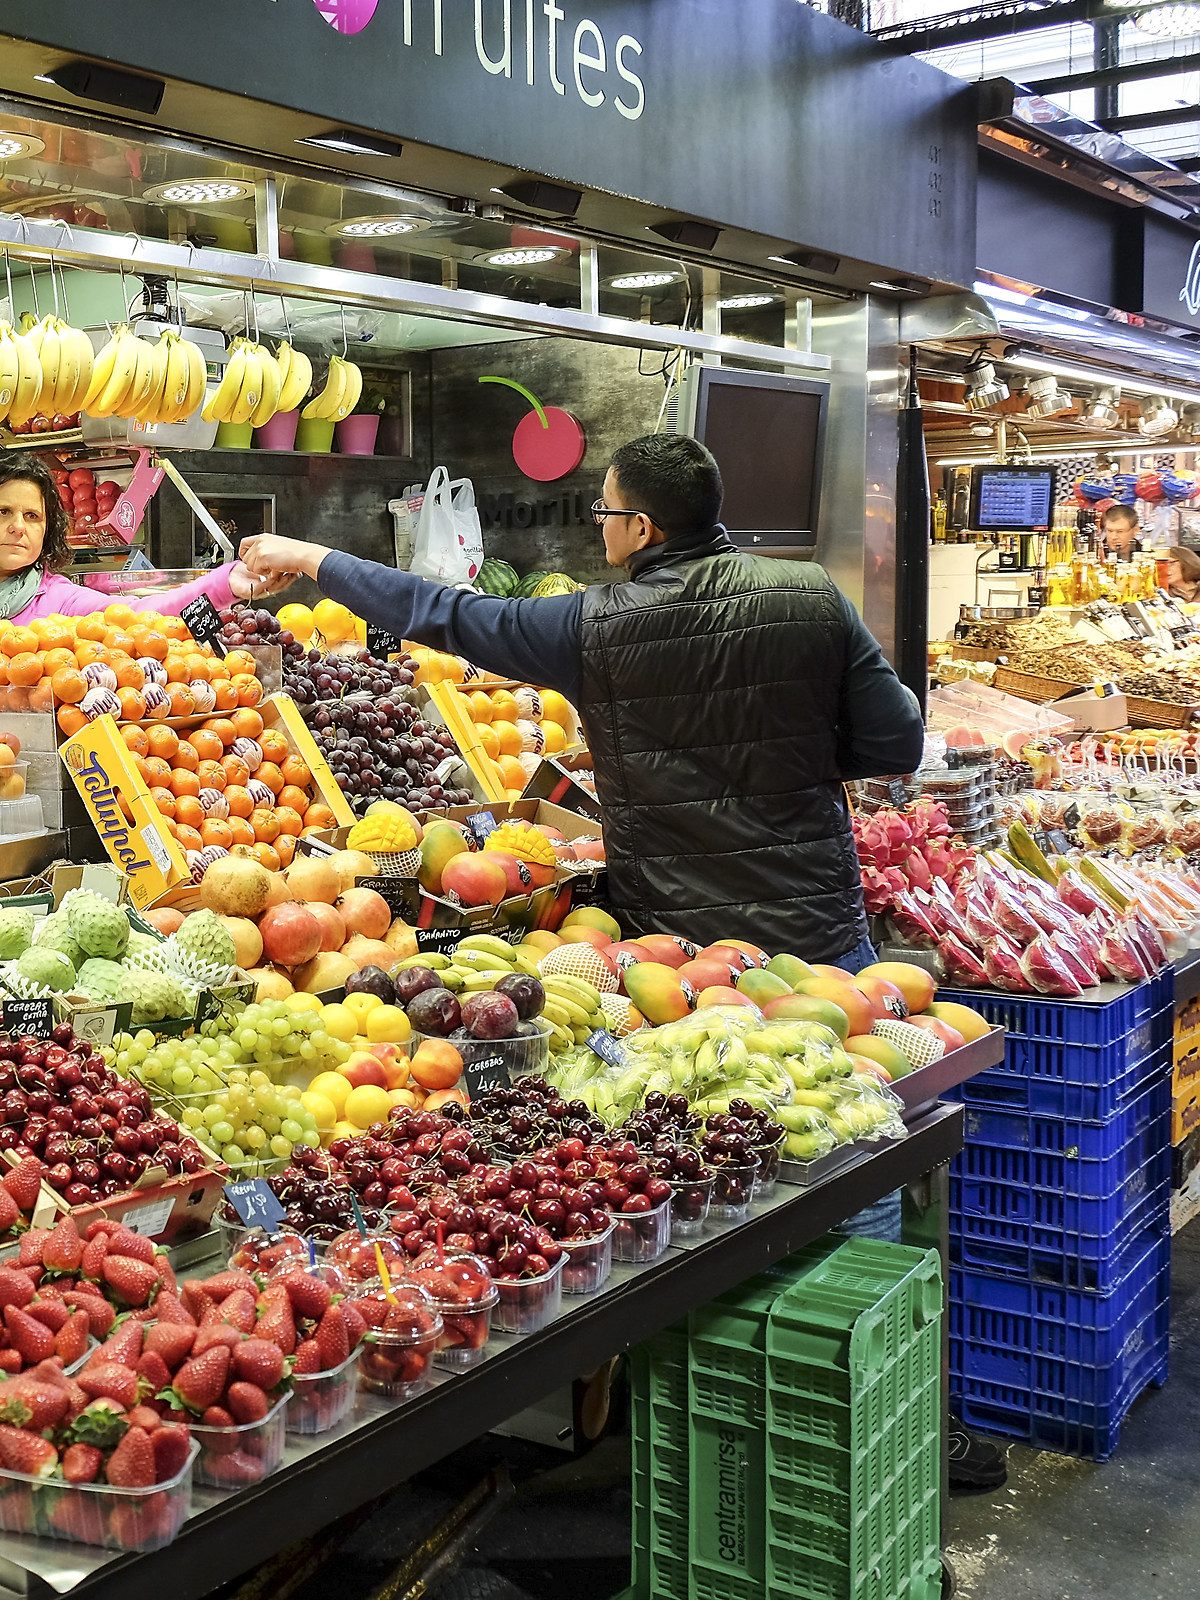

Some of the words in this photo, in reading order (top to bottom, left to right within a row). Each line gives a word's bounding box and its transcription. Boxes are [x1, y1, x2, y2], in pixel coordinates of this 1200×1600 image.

[403, 0, 645, 121] uites
[418, 929, 461, 942] BANANITO
[7, 1001, 48, 1012] CEREZAS
[468, 1056, 504, 1073] CEREZAS
[713, 1430, 737, 1562] centramirsa
